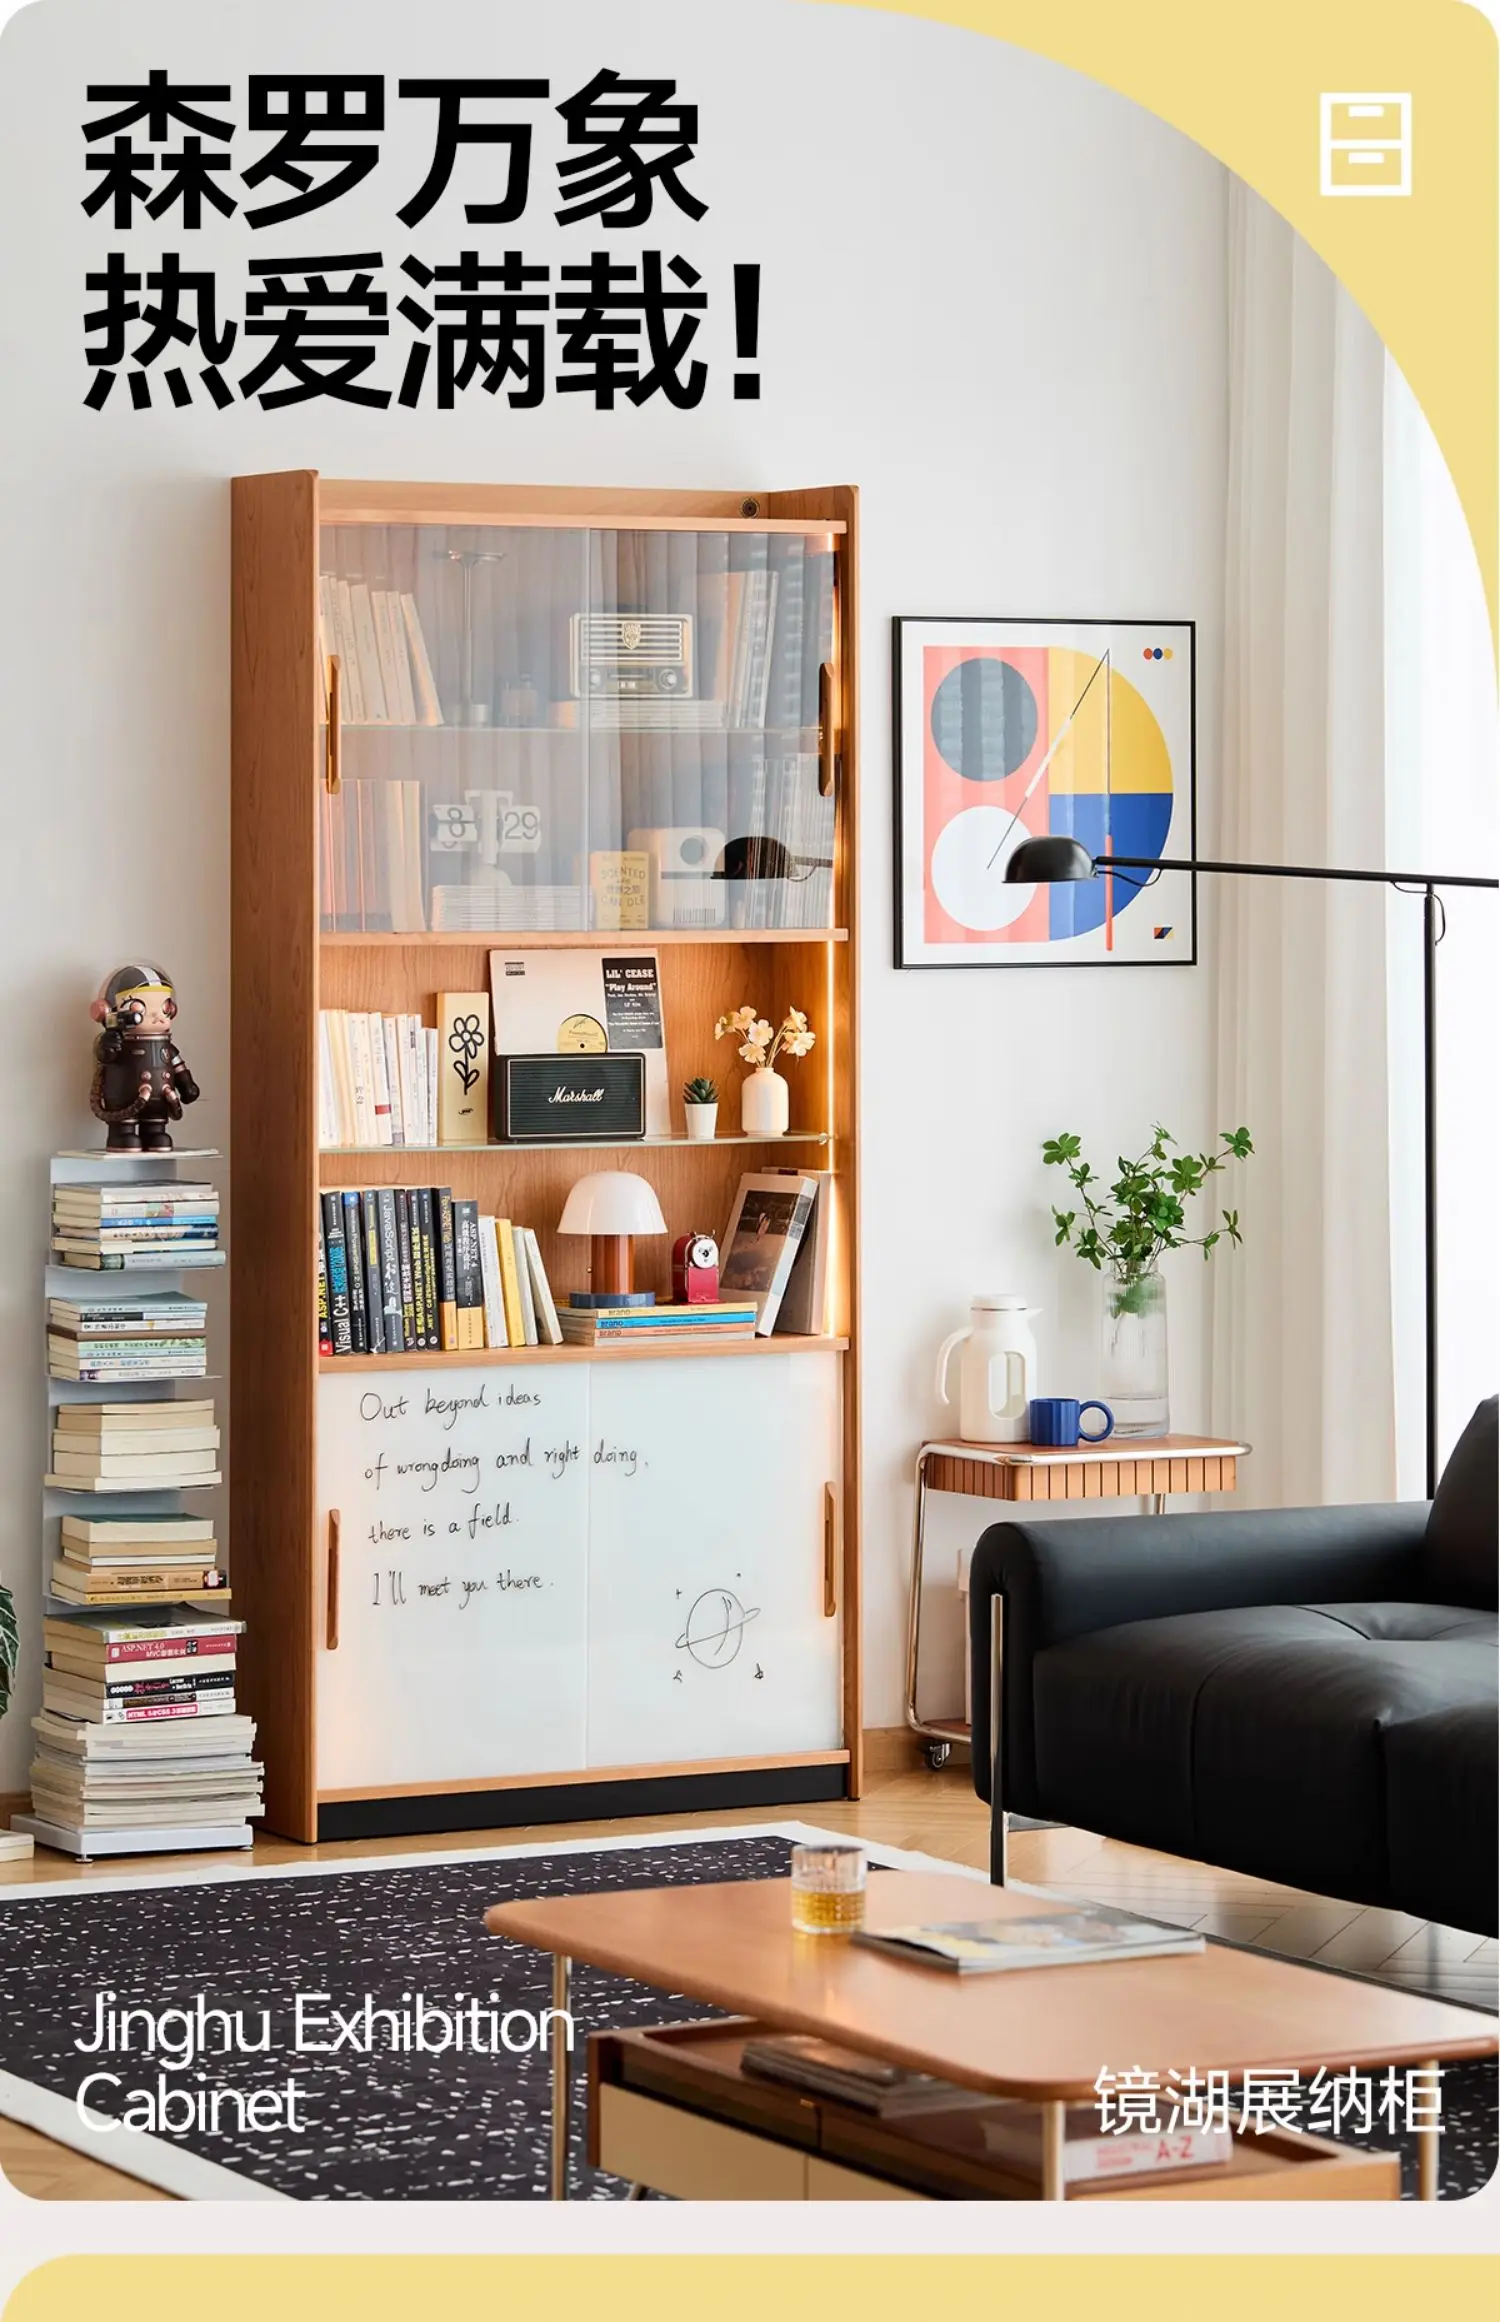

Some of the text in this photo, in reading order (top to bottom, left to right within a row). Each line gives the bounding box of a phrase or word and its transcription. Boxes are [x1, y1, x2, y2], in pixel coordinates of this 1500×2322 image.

[504, 811, 539, 840] 29
[625, 969, 654, 978] CEASE
[548, 1086, 605, 1103] Marshall
[384, 1205, 396, 1262] JavaScript
[333, 1294, 349, 1317] C++
[334, 1318, 352, 1353] Visual
[360, 1384, 542, 1430] Out beyond ideas
[364, 1452, 388, 1490] of
[496, 1437, 533, 1468] and
[544, 1440, 581, 1479] right
[368, 1521, 412, 1544] there
[423, 1518, 435, 1536] is
[448, 1522, 461, 1534] a
[372, 1570, 407, 1606] I'll
[418, 1576, 451, 1597] meet
[459, 1580, 488, 1610] you
[1156, 2135, 1194, 2162] A-Z
